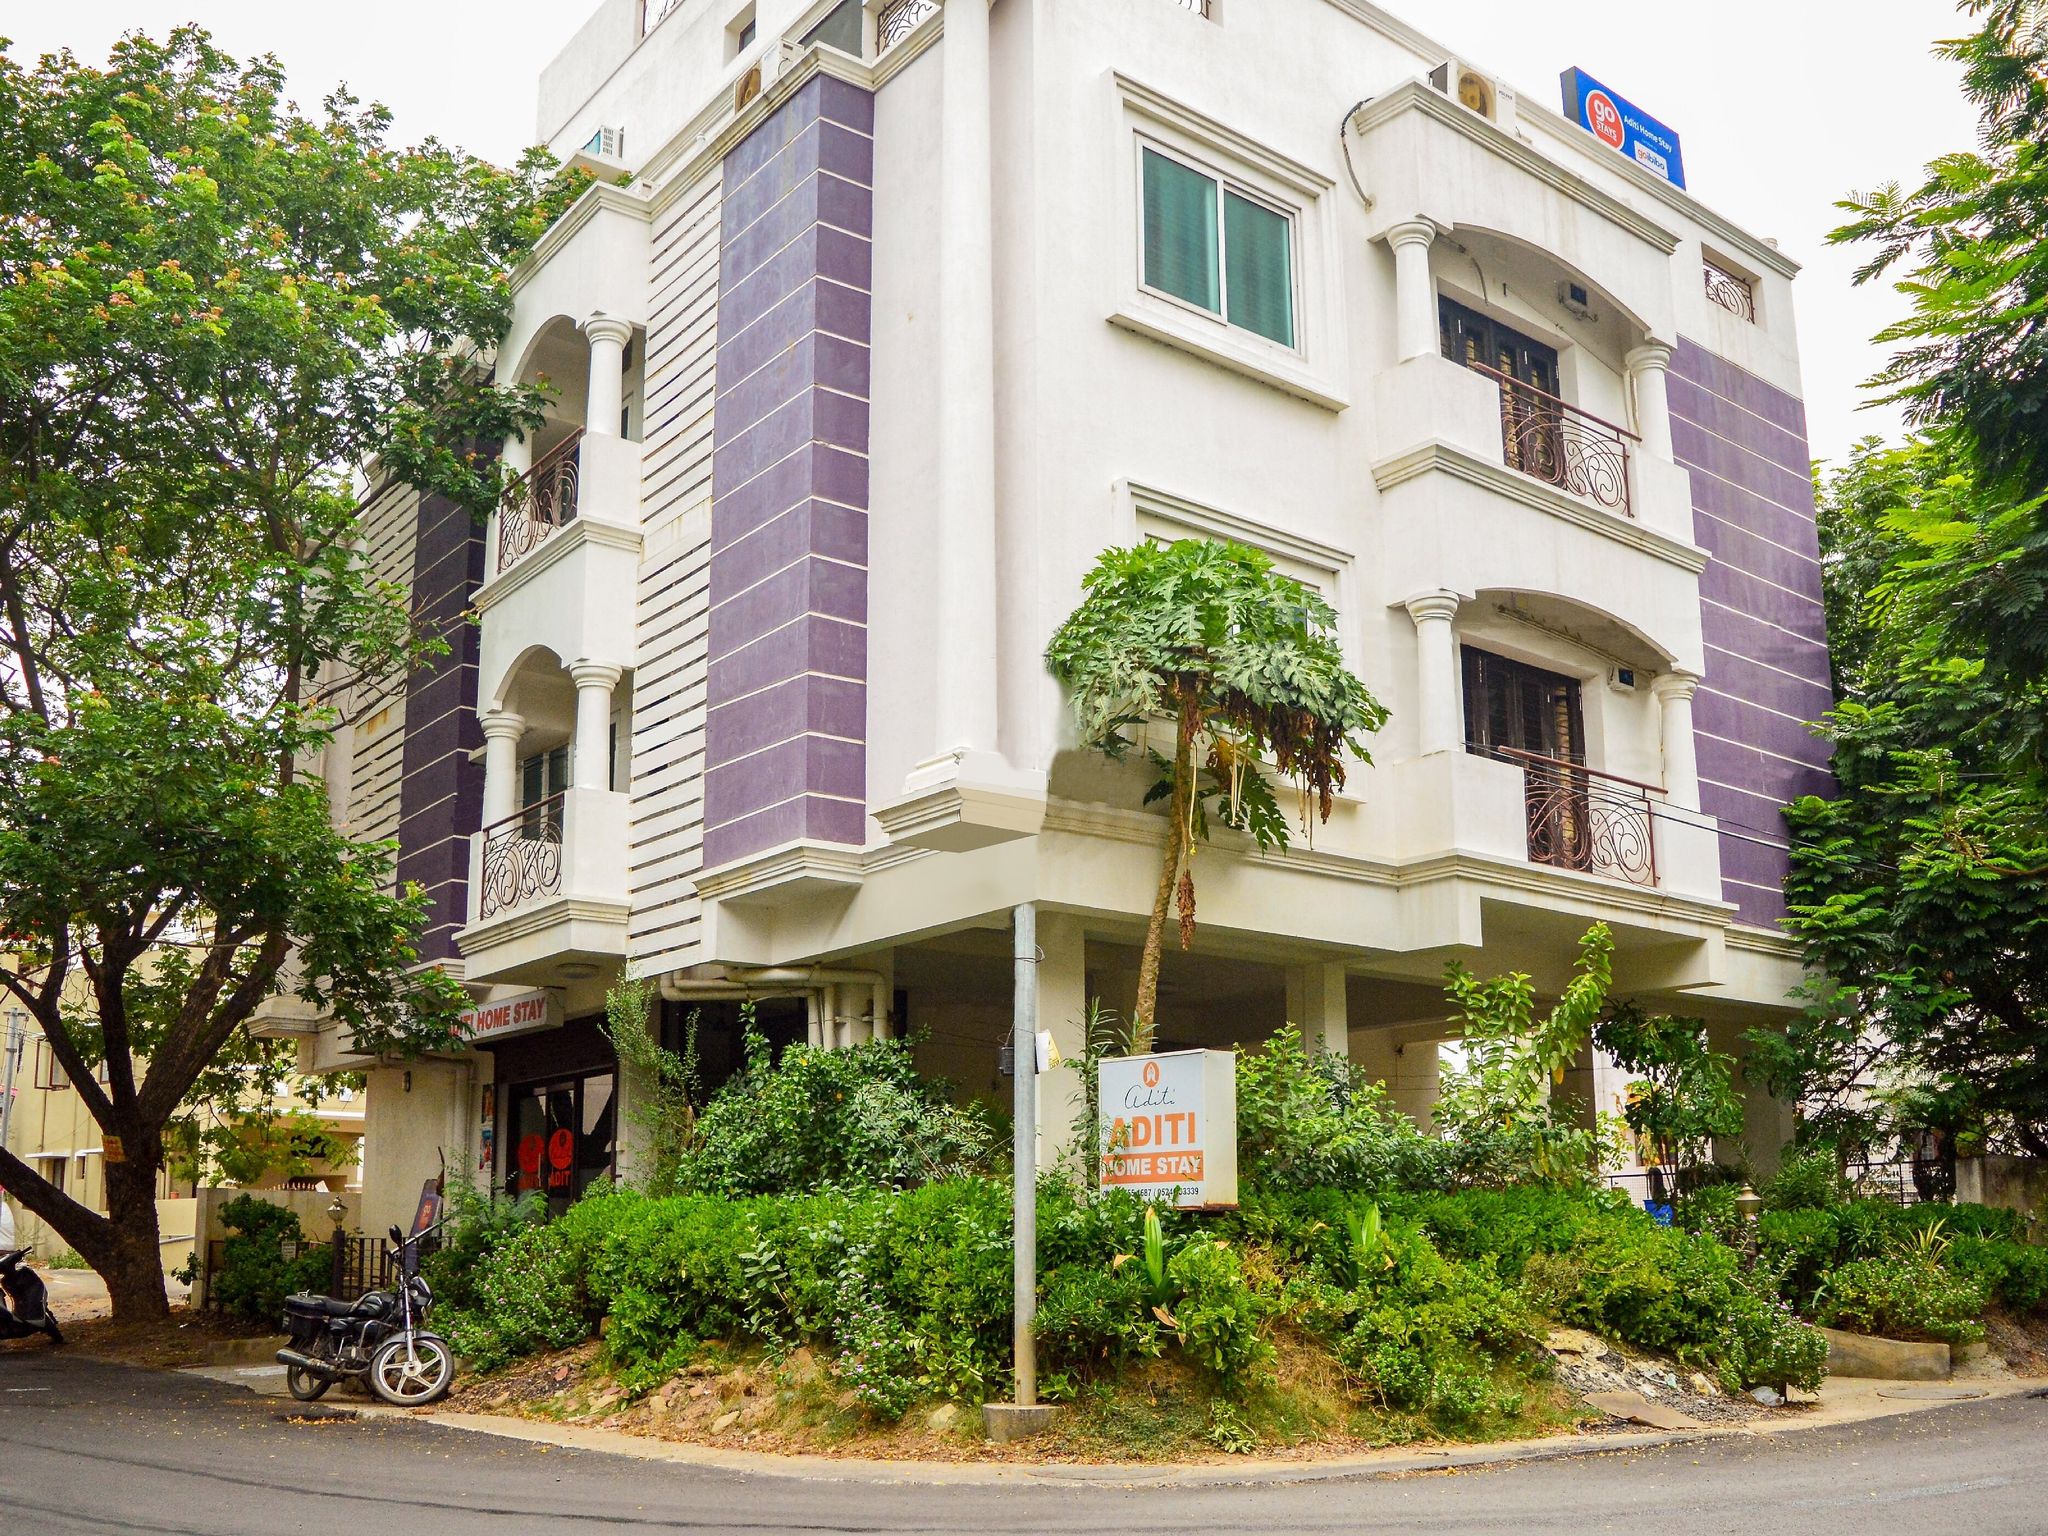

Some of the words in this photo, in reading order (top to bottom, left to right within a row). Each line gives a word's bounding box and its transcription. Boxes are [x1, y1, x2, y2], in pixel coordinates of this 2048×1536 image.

[1594, 99, 1616, 124] go
[1596, 120, 1618, 142] STAYS
[1624, 114, 1640, 131] Aditi
[1640, 124, 1658, 143] Home
[1658, 136, 1672, 153] Stay
[476, 1005, 511, 1032] HOME
[513, 997, 546, 1024] STAY
[1108, 1112, 1196, 1153] ADITI
[1156, 1155, 1200, 1175] STAY
